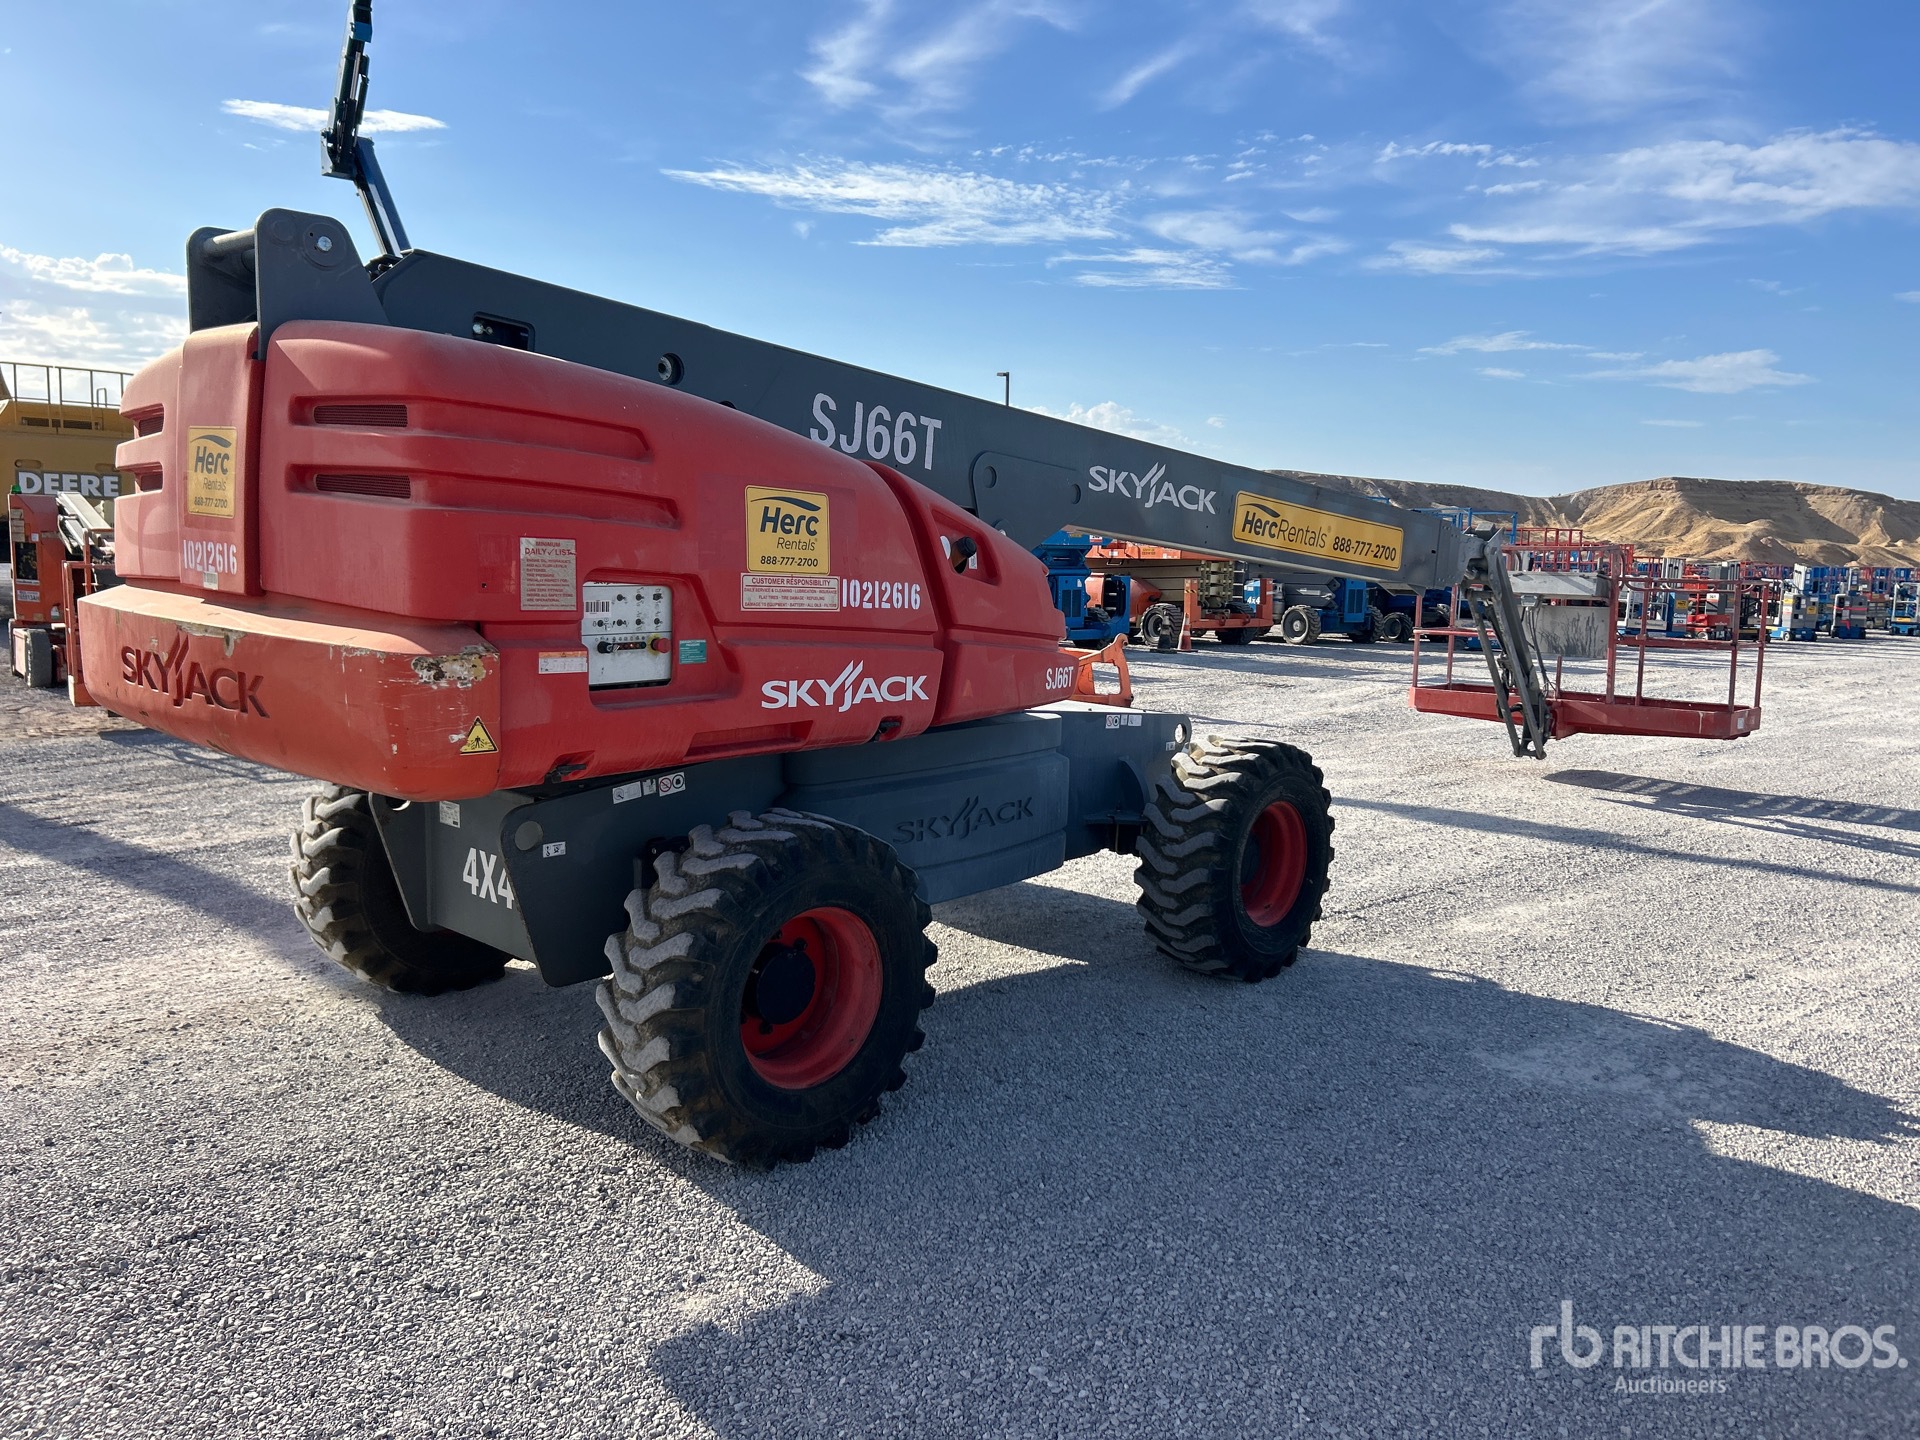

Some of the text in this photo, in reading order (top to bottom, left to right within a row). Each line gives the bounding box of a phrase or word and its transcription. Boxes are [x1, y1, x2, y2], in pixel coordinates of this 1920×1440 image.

[809, 392, 942, 470] SJ66T
[194, 445, 230, 476] Herc
[18, 471, 119, 498] DEERE
[202, 477, 226, 491] Rentals
[1088, 462, 1218, 515] SKYJACK
[194, 497, 228, 509] 888-777-2700
[760, 506, 820, 537] Herc
[183, 540, 238, 575] 10212616
[525, 547, 546, 555] DAILY
[776, 537, 816, 551] Rentals
[1332, 536, 1397, 562] 888-777-2700
[760, 555, 819, 568] 888-777-2700
[842, 578, 921, 610] 10212616
[121, 633, 270, 719] SKYJACK
[761, 660, 929, 713] SKYJACK
[1046, 666, 1074, 691] SJ66T
[892, 795, 1033, 844] SKYJACK
[462, 847, 515, 910] 4X4
